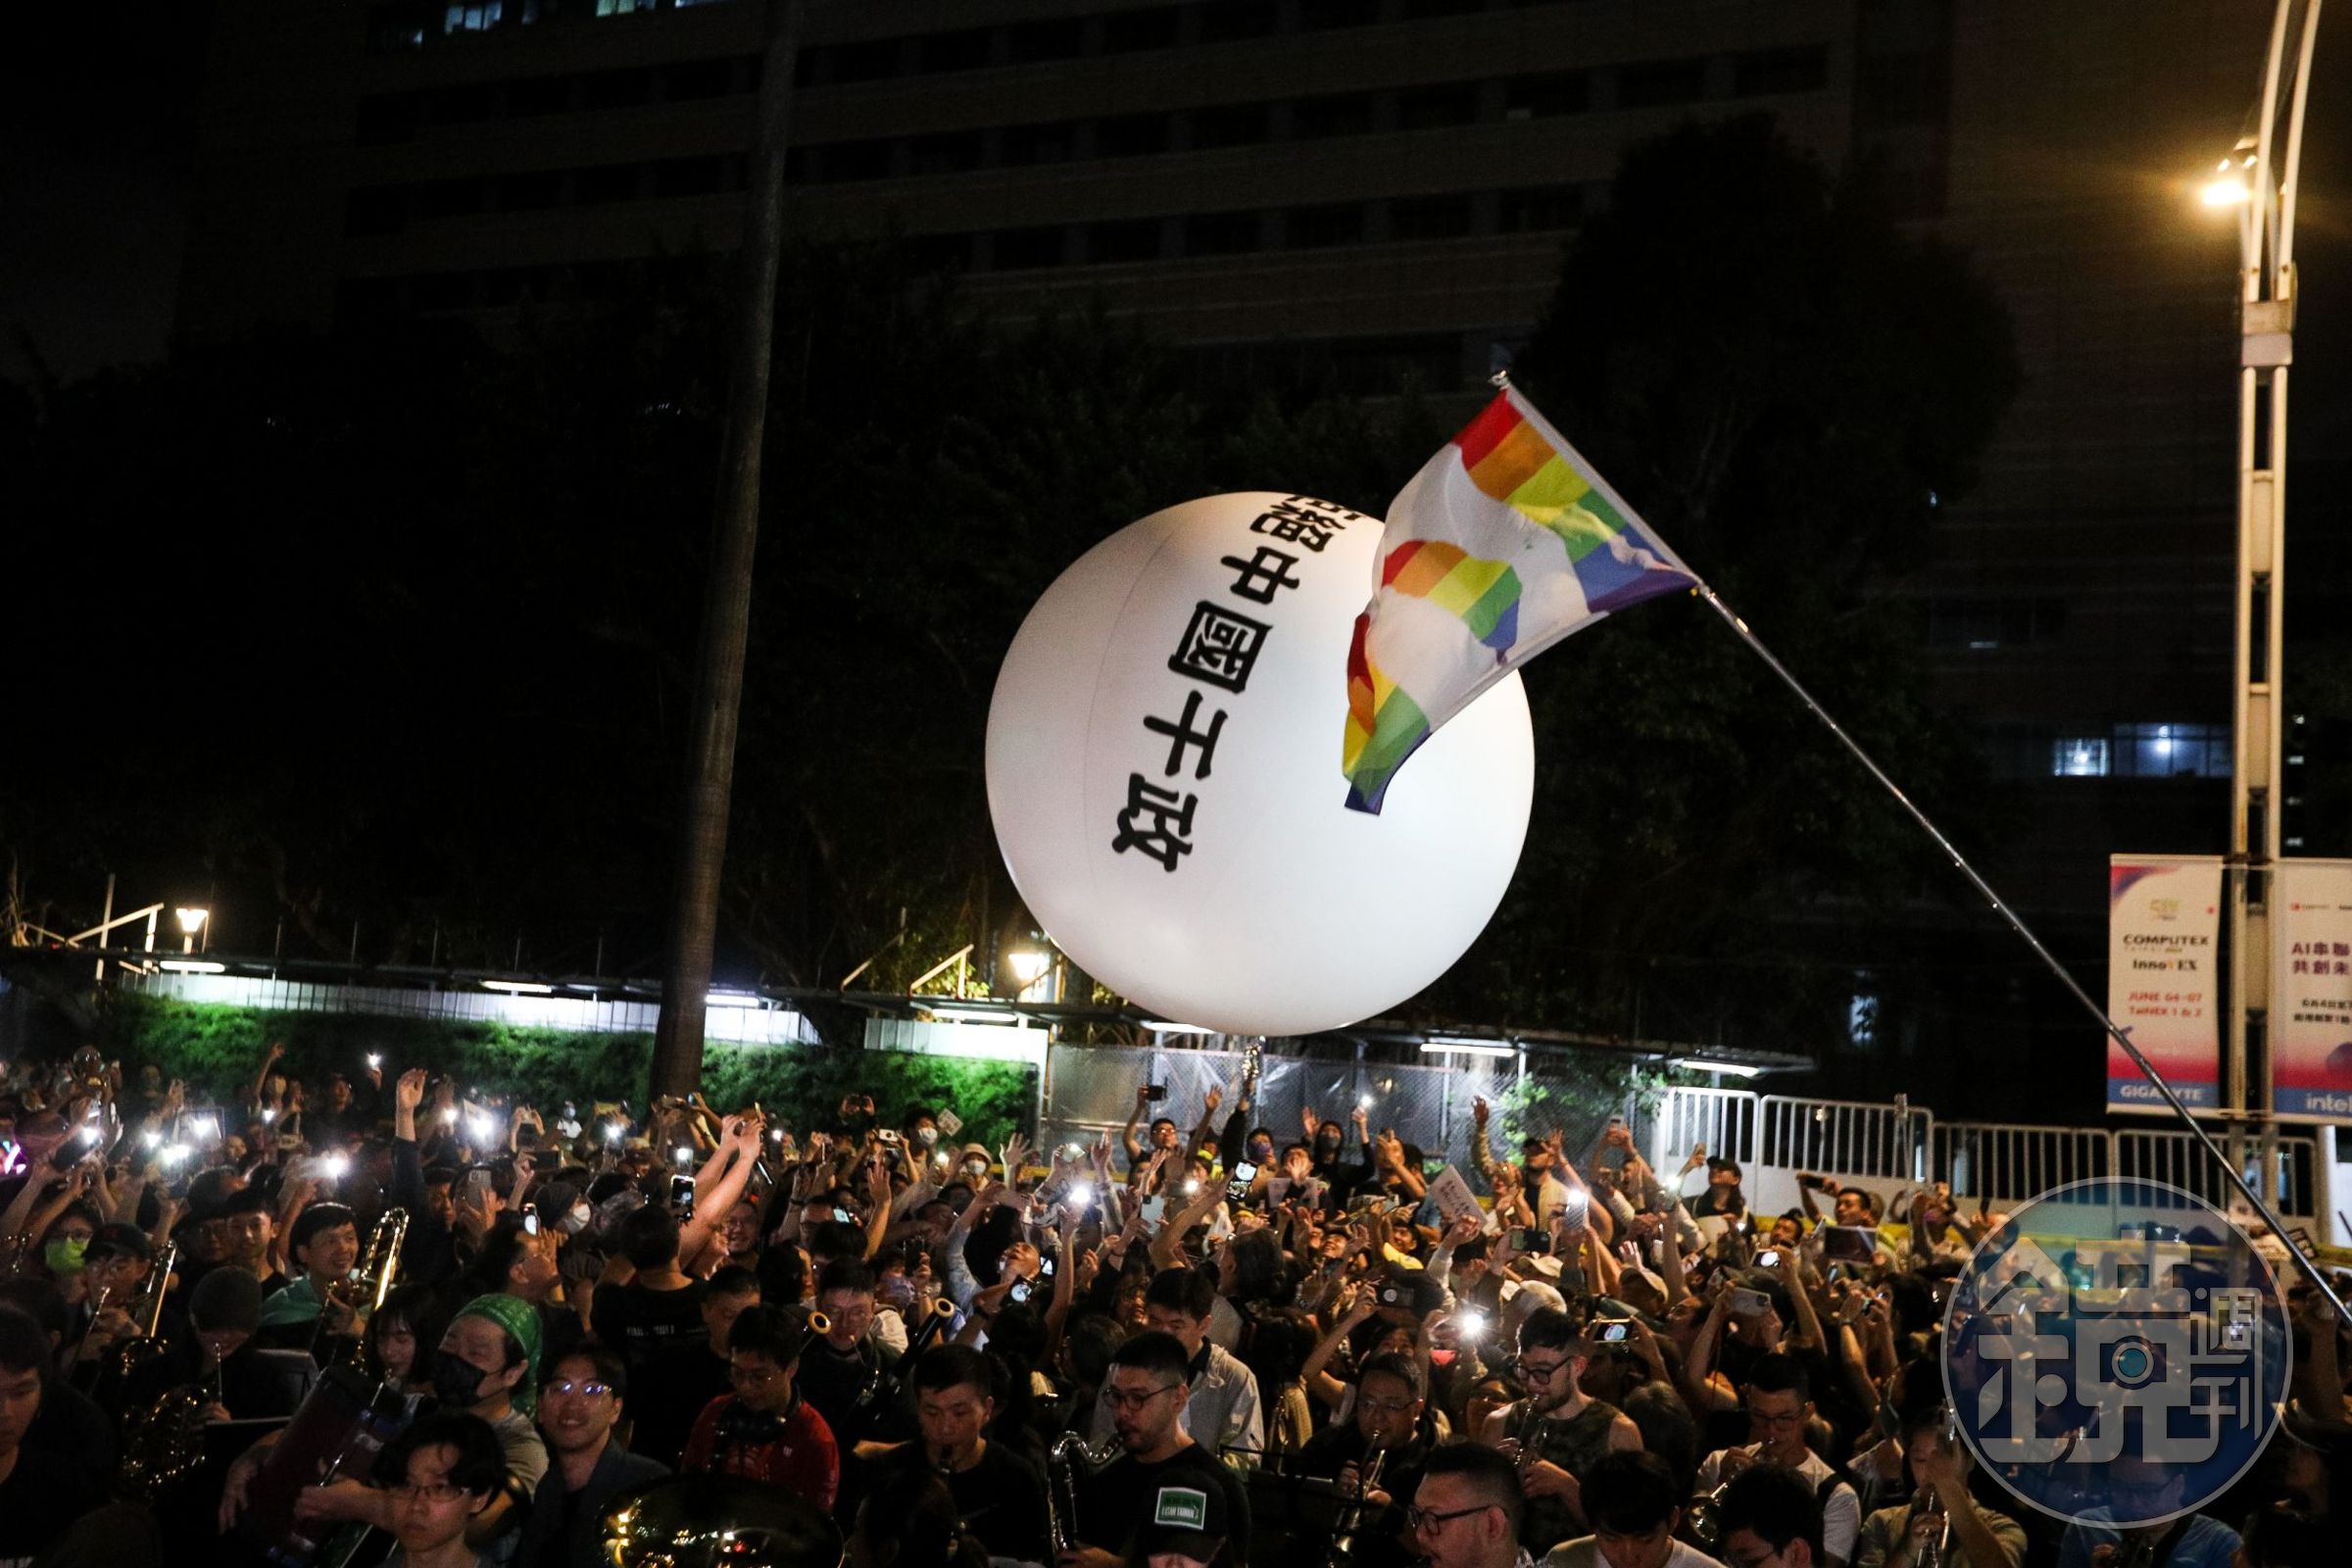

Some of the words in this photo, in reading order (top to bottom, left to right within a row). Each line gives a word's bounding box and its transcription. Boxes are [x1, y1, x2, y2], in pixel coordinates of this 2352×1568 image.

[1111, 494, 1367, 873] 絕中國干政
[2123, 934, 2209, 946] COMPUTEX
[2129, 992, 2160, 1002] JUNE
[2120, 1085, 2203, 1102] GIGAYTE
